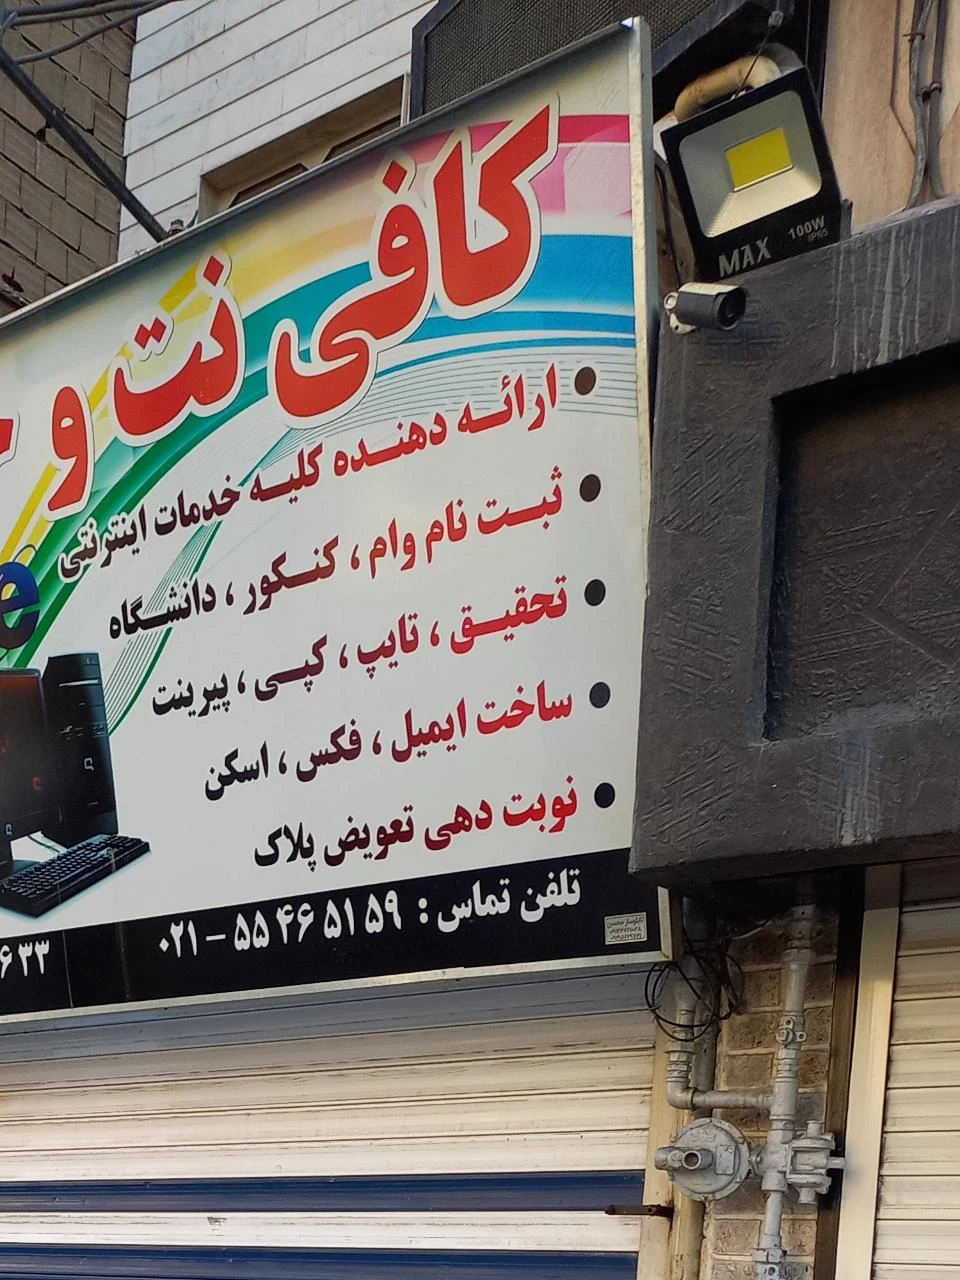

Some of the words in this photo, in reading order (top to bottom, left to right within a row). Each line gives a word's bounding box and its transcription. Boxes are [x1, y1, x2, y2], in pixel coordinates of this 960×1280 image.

[275, 103, 550, 418] کافی
[718, 236, 772, 278] MAX
[788, 215, 825, 240] 100W
[113, 256, 239, 437] نت
[458, 363, 557, 433] ارائه
[48, 386, 88, 511] و
[250, 442, 323, 503] کلیه
[334, 412, 447, 476] دهنده
[154, 475, 241, 536] خدمات
[426, 499, 467, 564] نام
[478, 466, 562, 534] ثبت
[61, 504, 146, 578] اینترنتی
[370, 518, 416, 579] وام
[243, 535, 338, 615] کنکور
[110, 578, 216, 638] دانشگاه
[450, 575, 567, 654] تحقیق
[255, 634, 327, 701] کپی
[357, 613, 418, 679] تایپ
[152, 674, 230, 717] پیرینت
[477, 680, 572, 734] ساخت
[296, 719, 362, 782] فکس
[392, 697, 466, 762] ایمیل
[205, 741, 269, 800] اسکن
[324, 805, 414, 866] تعویض
[424, 800, 493, 851] دهی
[503, 775, 578, 833] نوبت
[255, 822, 316, 872] پلاک
[520, 868, 581, 922] تلفن
